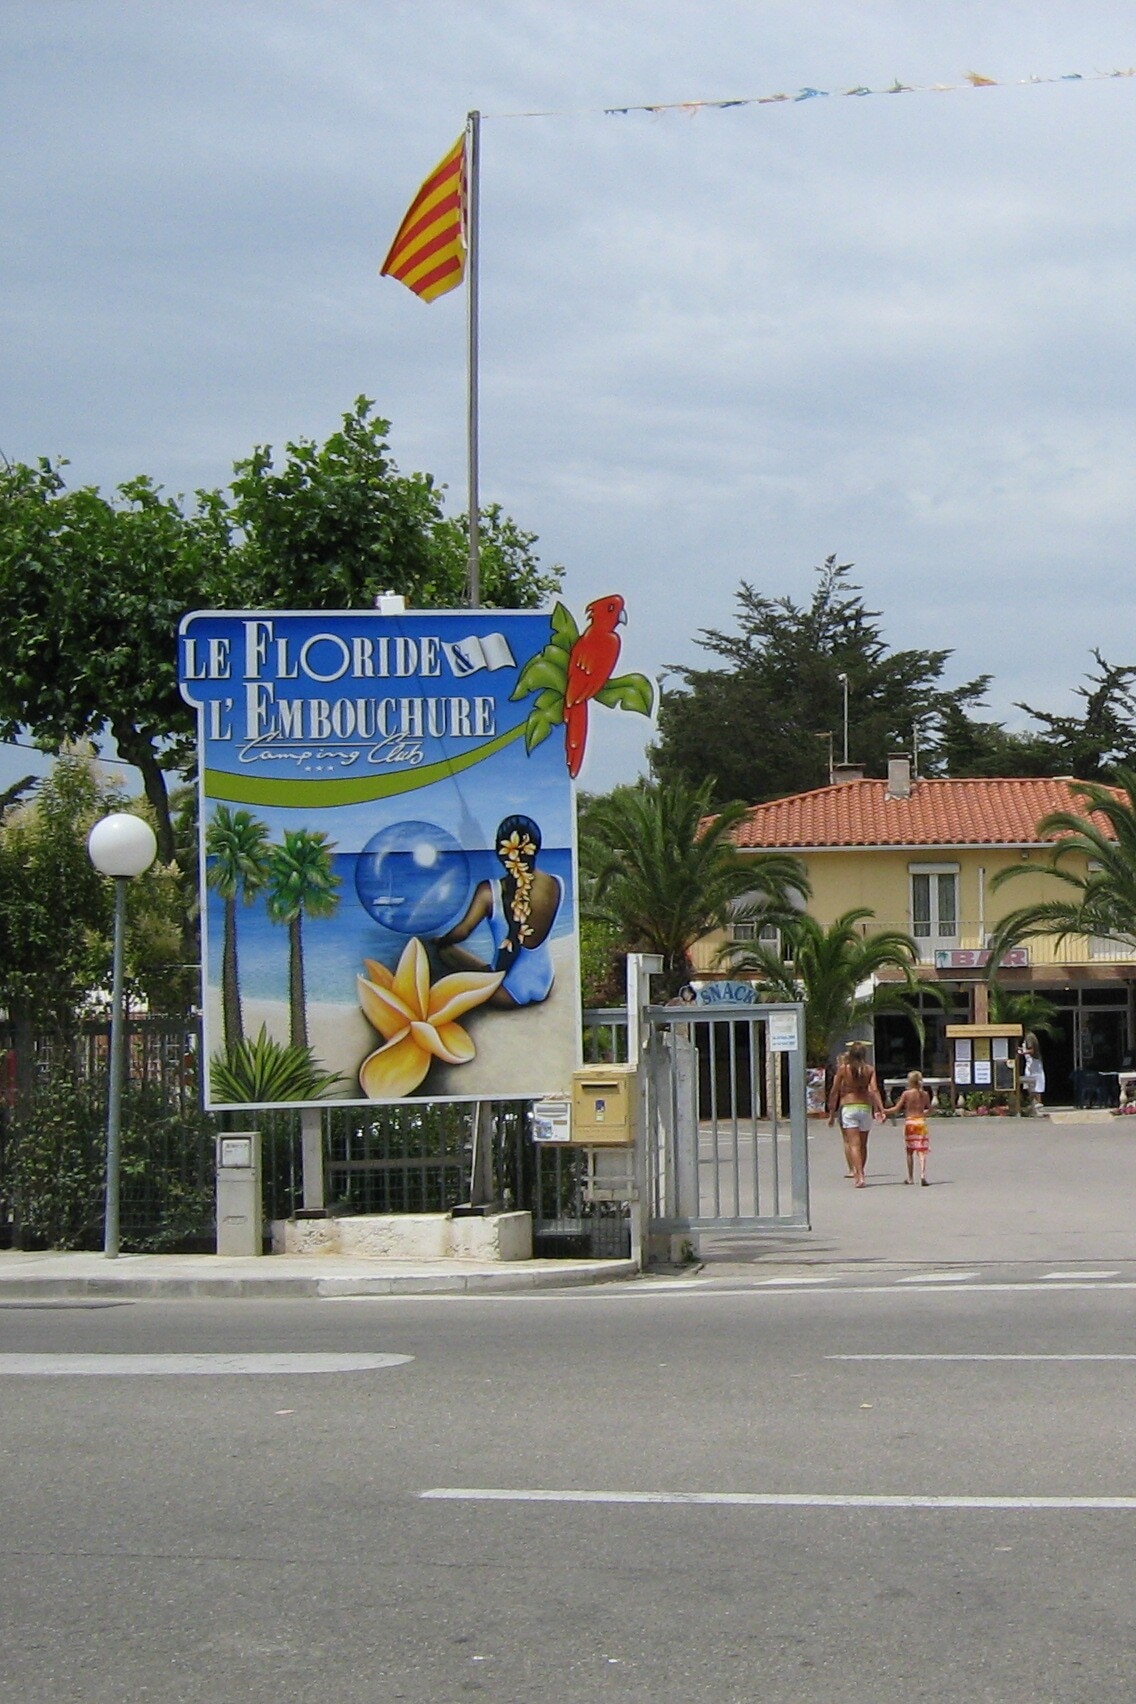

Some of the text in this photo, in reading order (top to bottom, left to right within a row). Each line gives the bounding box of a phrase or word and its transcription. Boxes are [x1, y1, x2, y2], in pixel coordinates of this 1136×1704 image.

[183, 620, 475, 682] LE FLORIDE &
[243, 682, 496, 741] EMBOUCHURE
[238, 730, 426, 767] Camping Club
[700, 982, 757, 1005] SNACK
